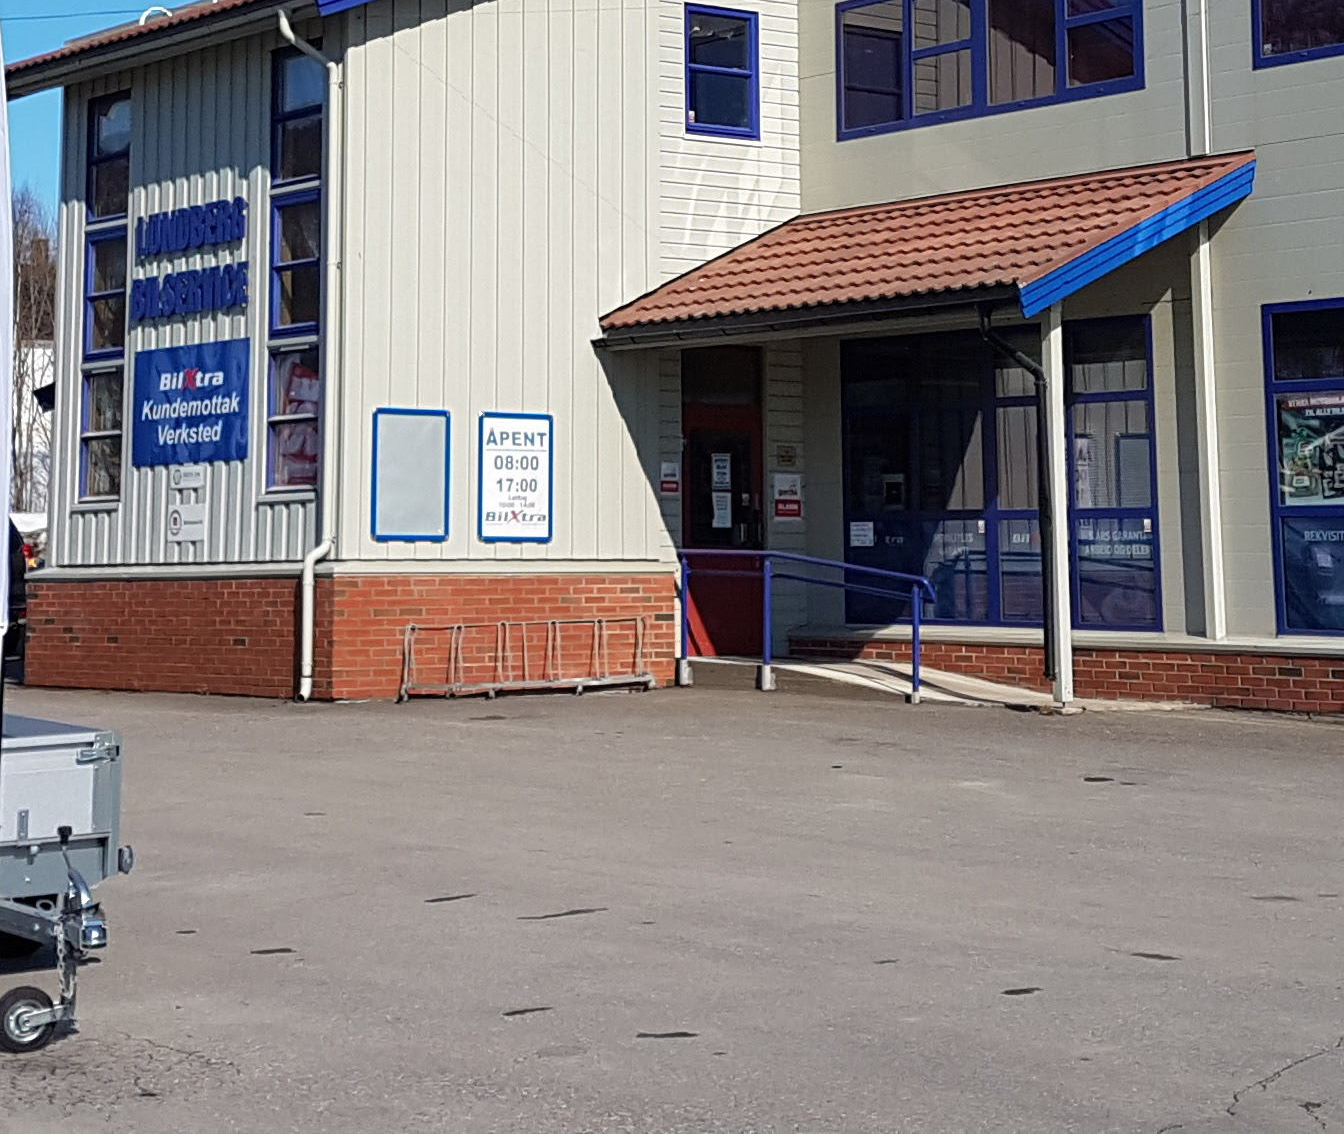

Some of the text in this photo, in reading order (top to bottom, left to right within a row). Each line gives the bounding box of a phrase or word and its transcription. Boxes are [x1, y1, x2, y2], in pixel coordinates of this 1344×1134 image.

[159, 367, 224, 391] BilXtra
[141, 391, 240, 422] Kundemottak
[157, 420, 223, 446] Verksted
[485, 427, 548, 447] ÅPENT
[493, 455, 539, 471] 08:00
[496, 478, 538, 493] 17:00
[485, 509, 547, 524] BilXtra
